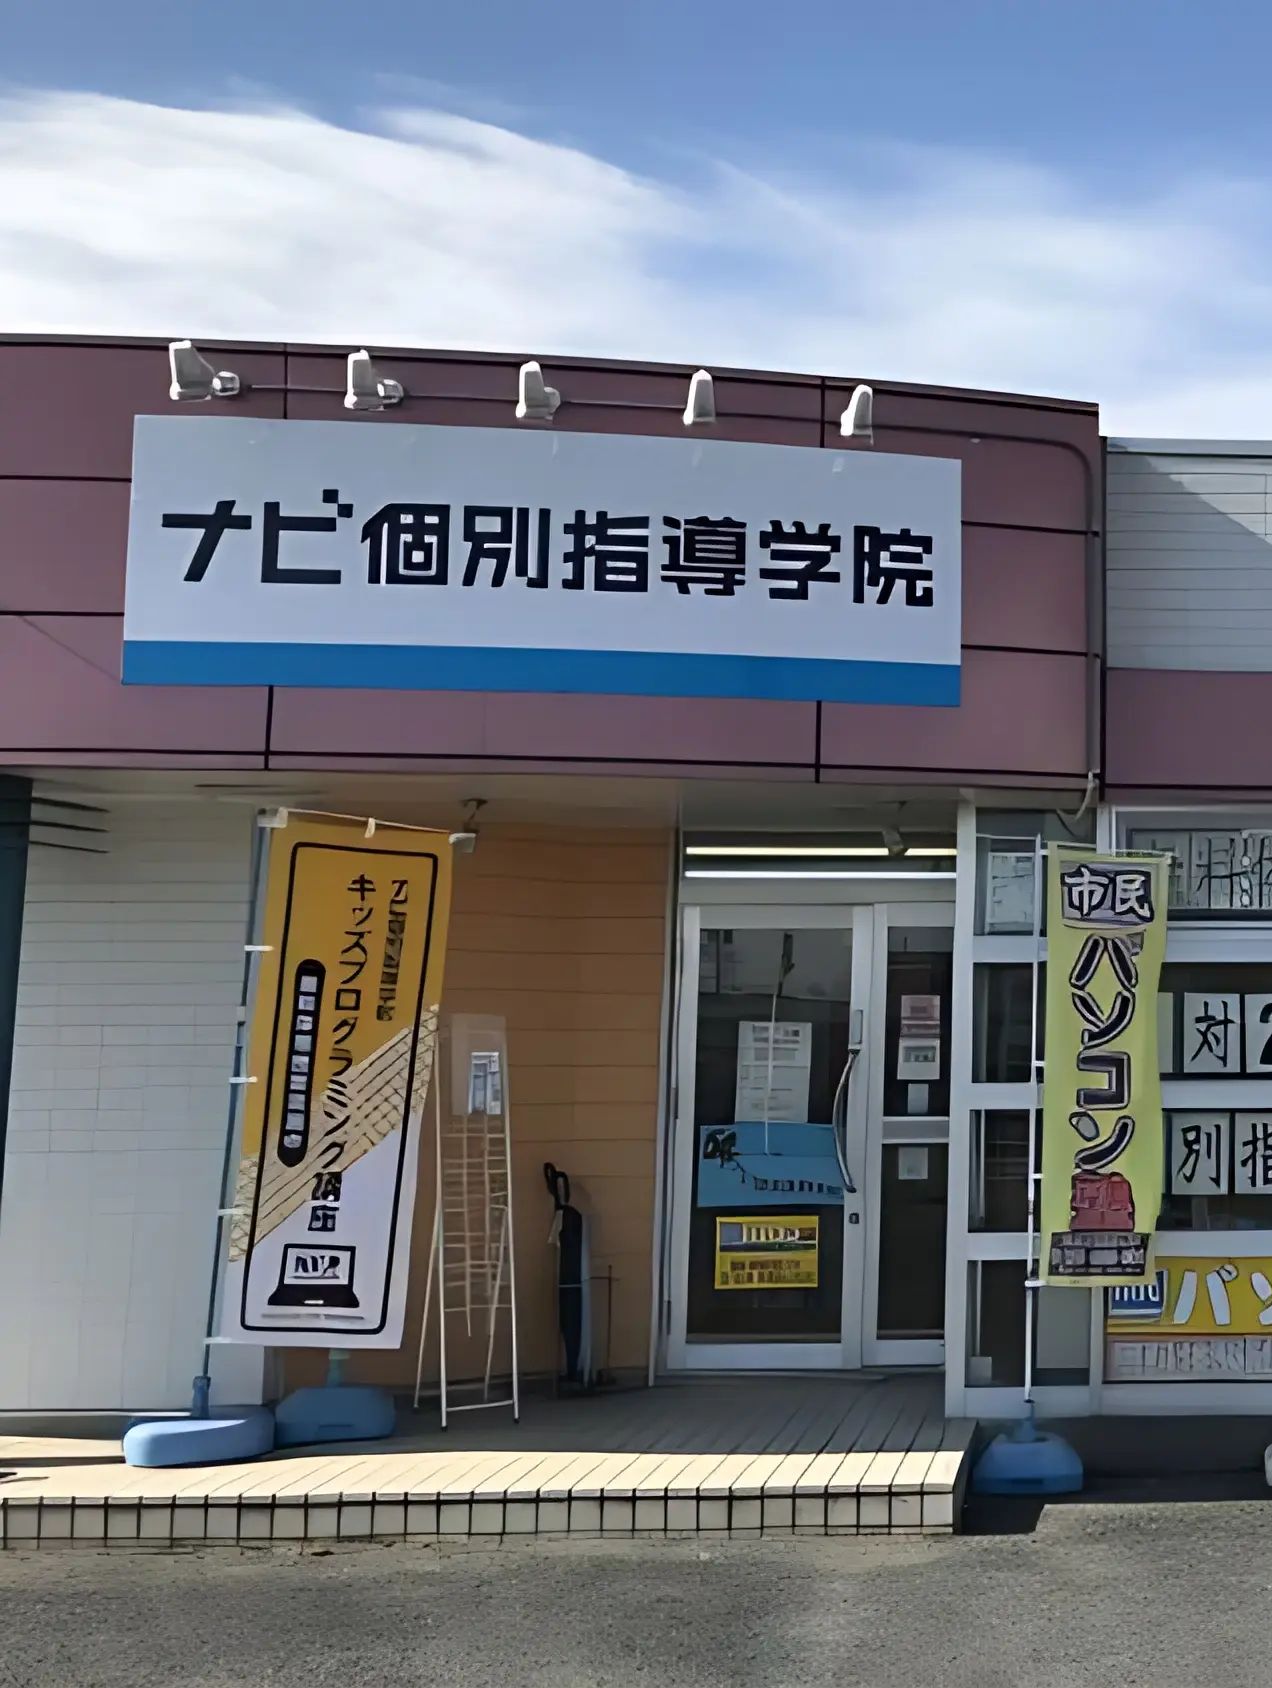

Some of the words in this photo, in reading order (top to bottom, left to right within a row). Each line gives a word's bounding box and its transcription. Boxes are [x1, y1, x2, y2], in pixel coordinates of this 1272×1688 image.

[161, 488, 935, 608] ナビ個別指導学院
[1062, 860, 1155, 924] 市民
